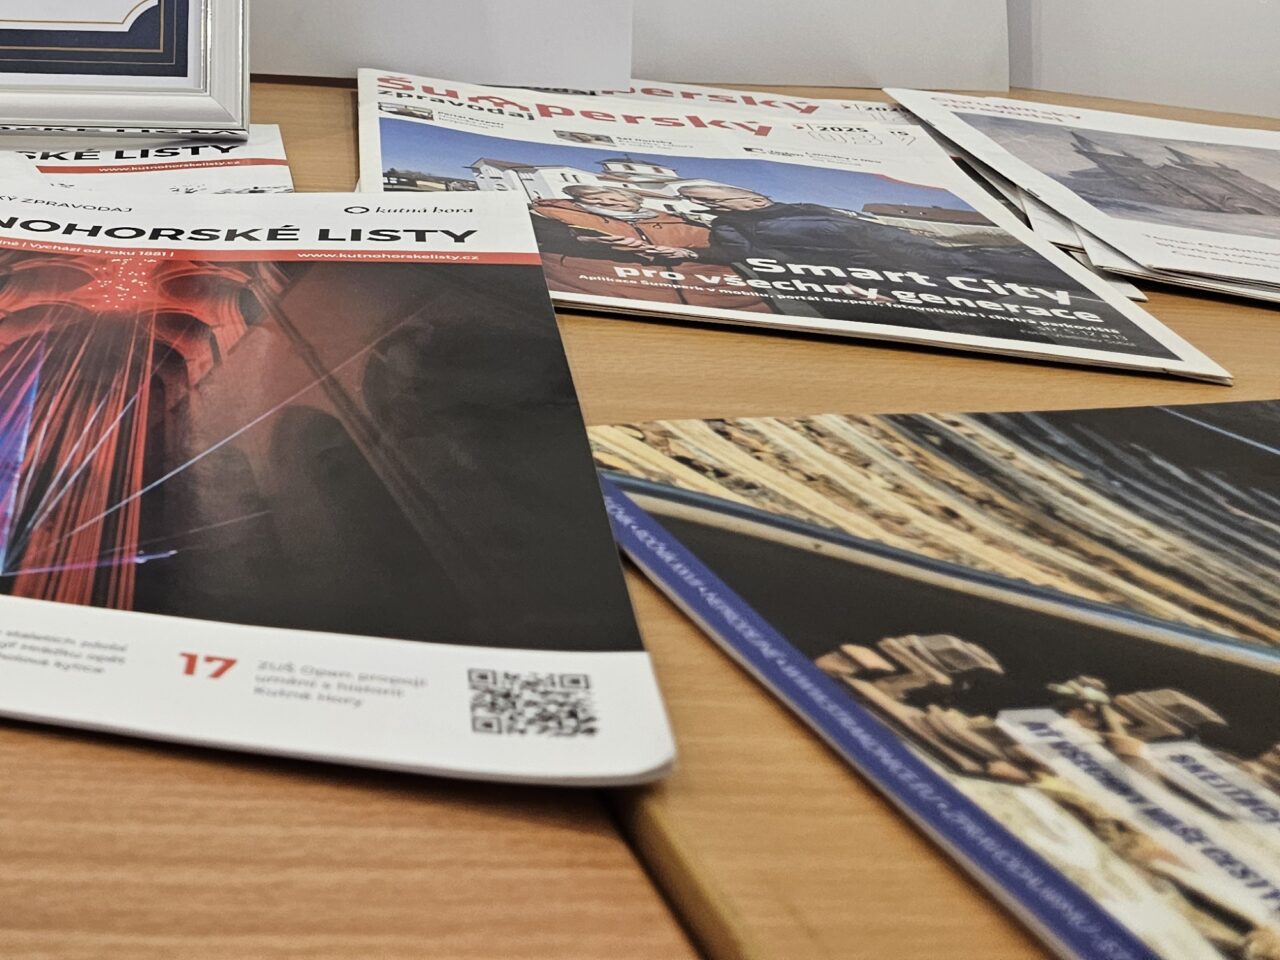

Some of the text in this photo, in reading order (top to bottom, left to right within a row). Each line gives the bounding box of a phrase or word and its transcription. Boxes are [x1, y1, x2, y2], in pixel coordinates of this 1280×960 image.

[378, 90, 535, 121] zpravodaj
[115, 144, 240, 159] LISTY
[21, 197, 134, 213] ZPRAVODAJ
[375, 206, 474, 214] kutná hora
[318, 228, 478, 243] LISTY
[29, 242, 82, 254] Vychází
[104, 250, 137, 258] roku
[138, 250, 167, 258] 1881
[297, 251, 479, 261] www.kutnohorskelisty.cz
[579, 274, 638, 285] Aplikace
[640, 280, 704, 292] Šumperk
[777, 293, 820, 303] portál
[746, 257, 1072, 306] Smart City
[613, 266, 1104, 323] pro všechny generace
[178, 652, 238, 679] 17
